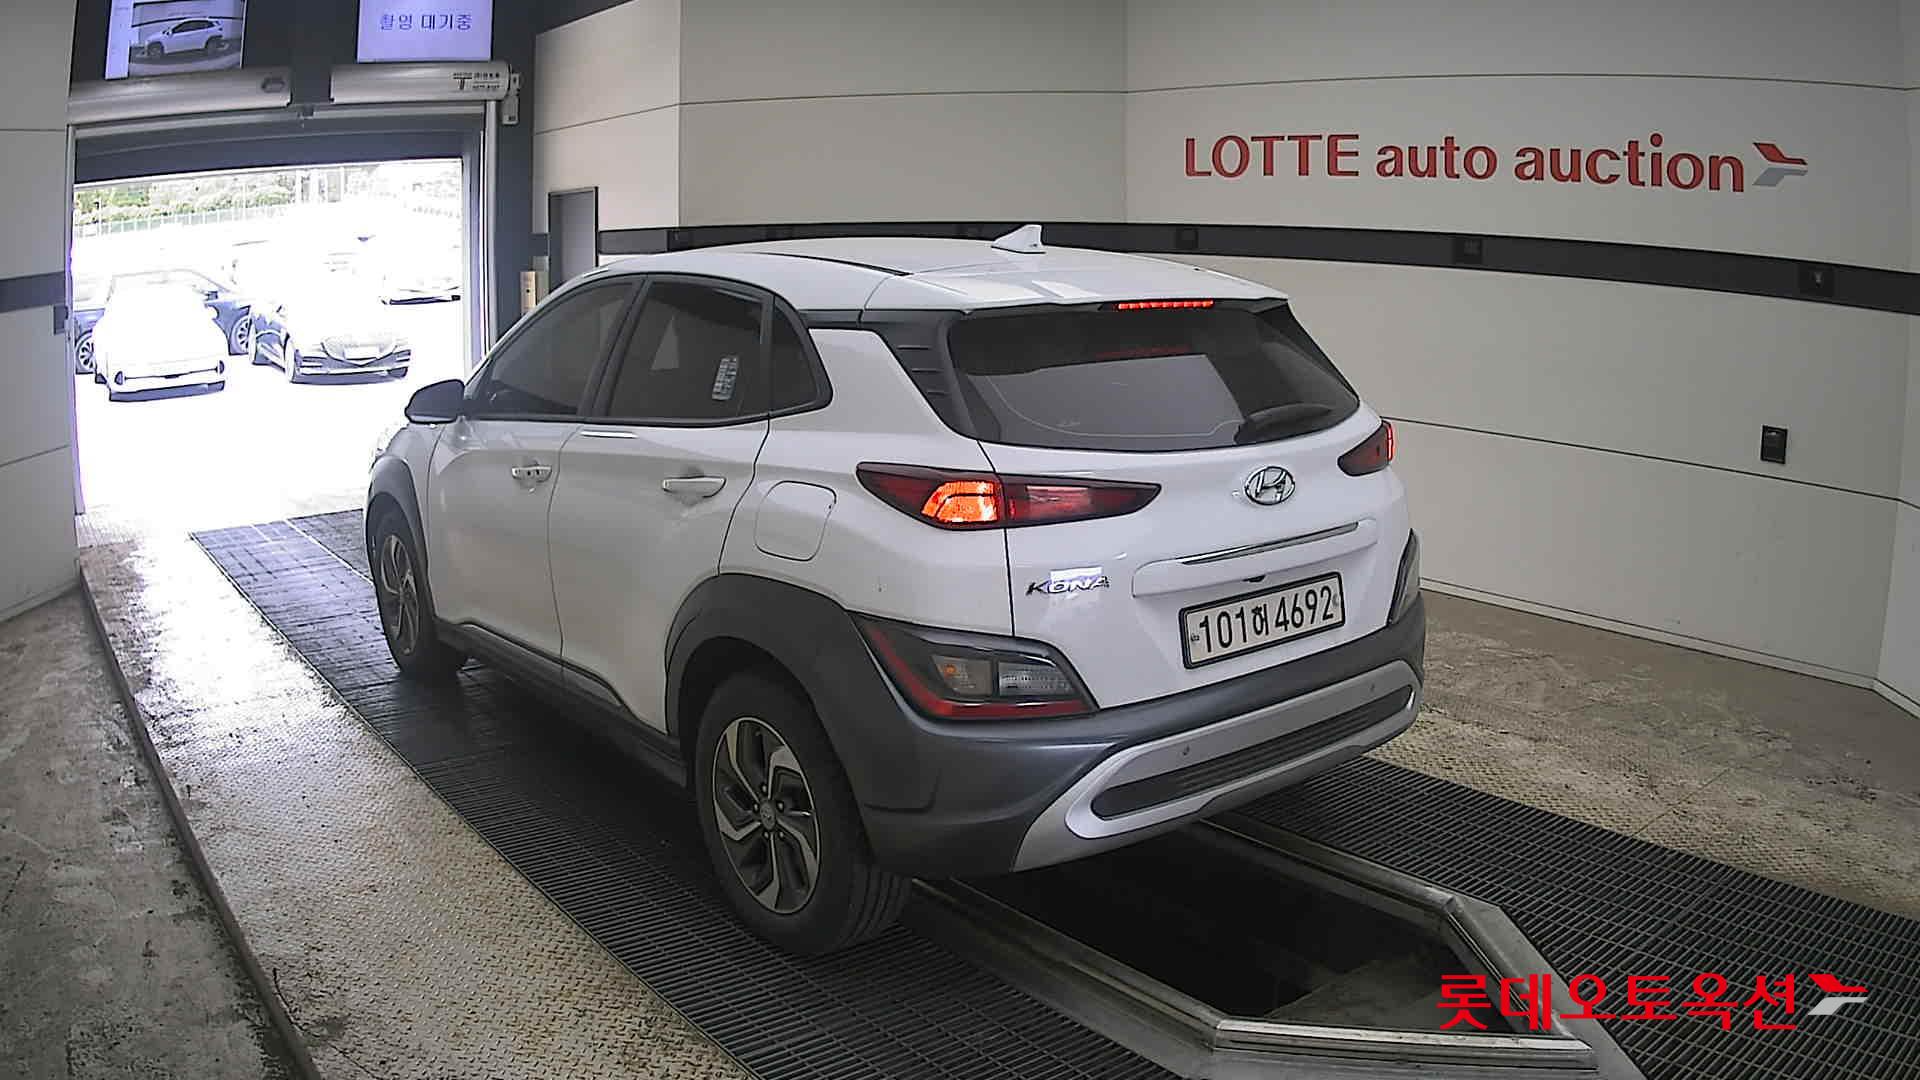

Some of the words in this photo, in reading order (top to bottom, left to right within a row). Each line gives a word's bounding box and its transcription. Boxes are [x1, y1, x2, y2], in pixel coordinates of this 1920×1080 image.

[421, 13, 473, 31] 대기중
[1185, 133, 1360, 178] LOTTE
[1376, 136, 1498, 180] auto
[1515, 133, 1745, 193] auction
[1026, 575, 1110, 596] KONA
[1199, 585, 1334, 653] 101허4692
